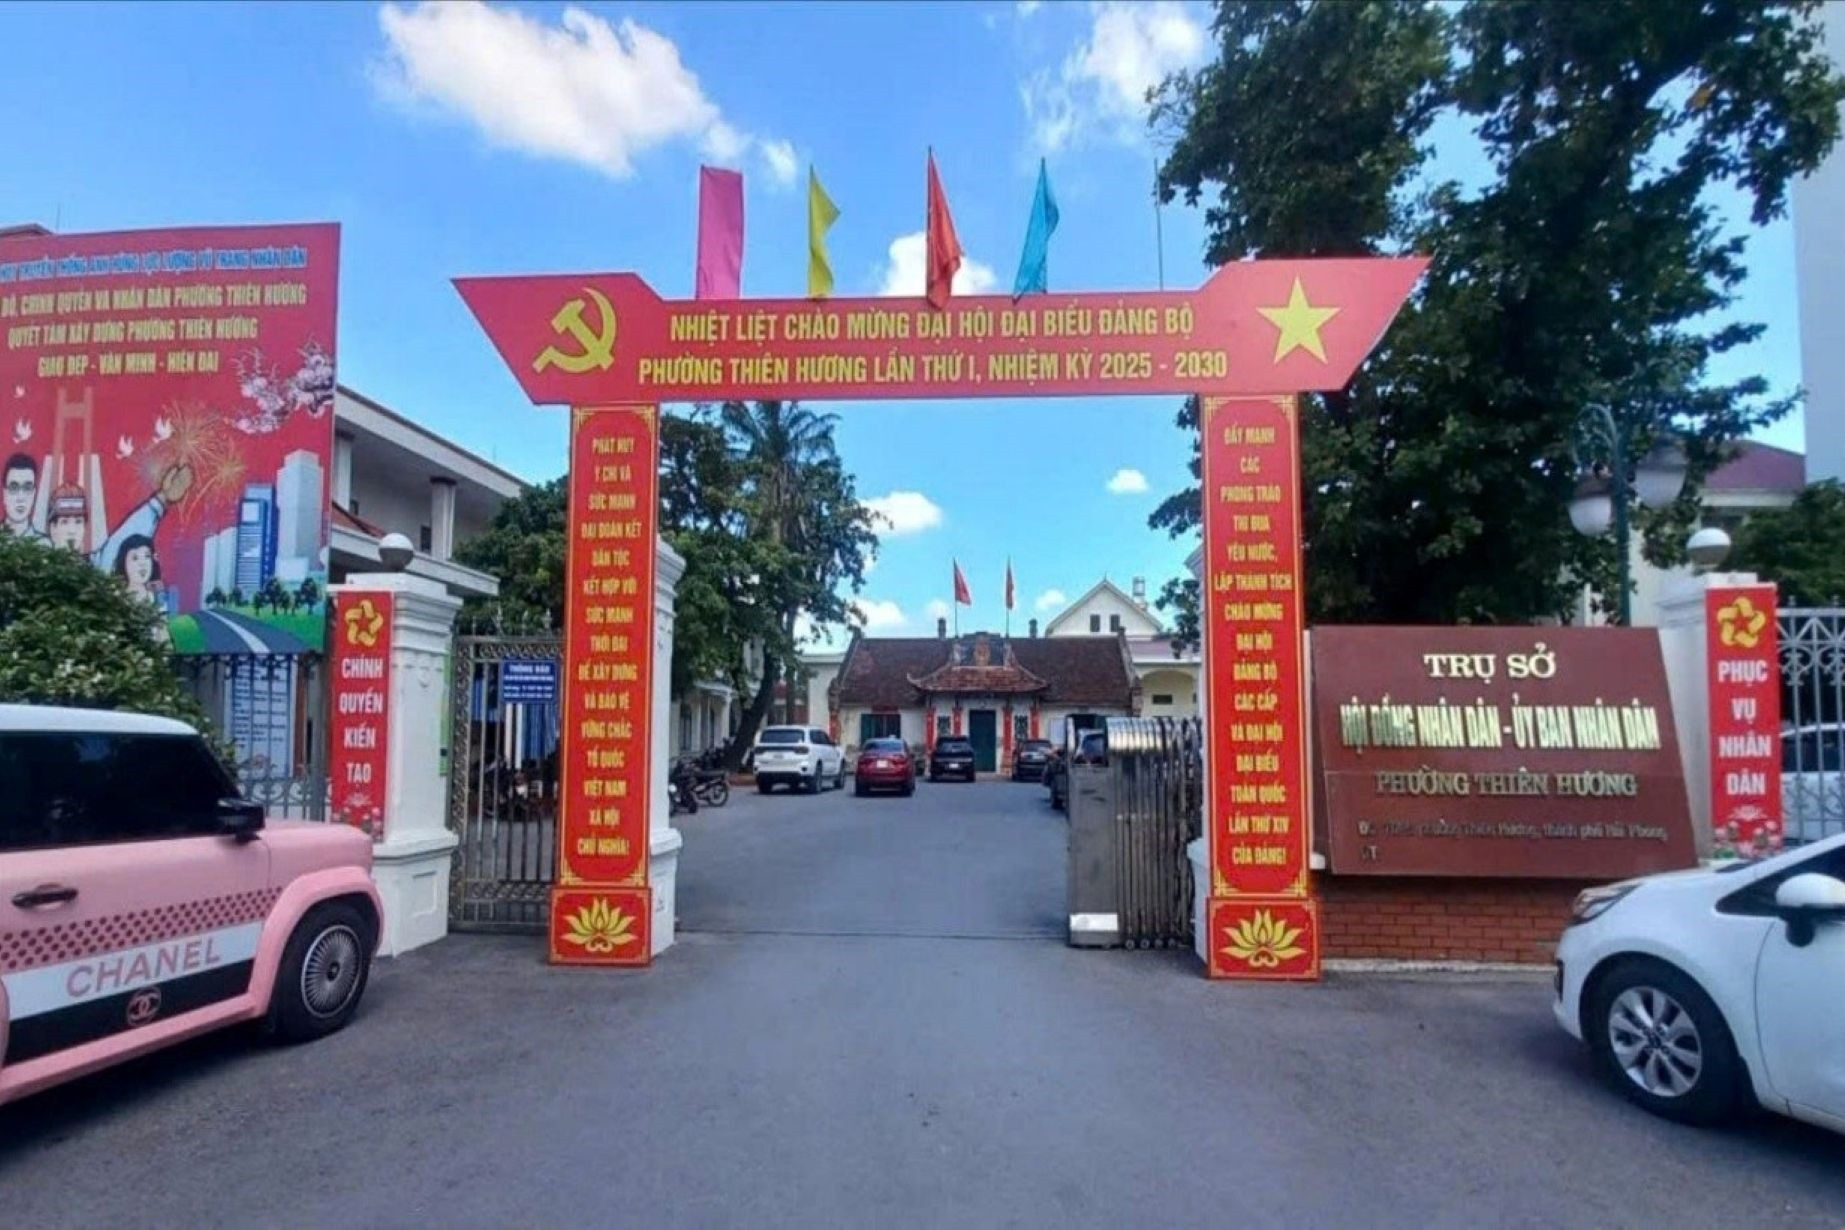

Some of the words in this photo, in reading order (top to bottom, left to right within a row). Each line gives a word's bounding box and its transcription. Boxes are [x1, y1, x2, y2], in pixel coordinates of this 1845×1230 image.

[215, 250, 249, 270] TRANG
[670, 308, 730, 346] NHIỆT
[737, 308, 778, 346] LIỆT
[785, 307, 840, 340] CHÀO
[847, 306, 910, 339] MỪNG
[917, 310, 951, 344] ĐẠI
[959, 305, 993, 343] HỘI
[1001, 309, 1036, 343] ĐẠI
[1043, 299, 1092, 336] BIỂU
[1099, 299, 1158, 335] ĐẢNG
[1165, 303, 1194, 340] BỘ
[638, 351, 724, 386] PHƯỜNG
[729, 352, 789, 384] THIÊN
[796, 355, 867, 383] HƯƠNG
[874, 347, 915, 382] LẦN
[922, 349, 964, 382] THỨ
[968, 355, 982, 384] I,
[988, 349, 1059, 387] NHIỆM
[1065, 347, 1094, 380] KỲ
[1100, 352, 1152, 379] 2025
[1174, 351, 1228, 379] 2030
[1220, 485, 1254, 504] PHONG
[341, 653, 384, 679] CHÍNH
[1423, 653, 1497, 685] TRỤ
[1506, 641, 1557, 679] SỞ
[1717, 659, 1768, 687] PHỤC
[339, 686, 383, 714] QUYỀN
[1731, 697, 1757, 725] VỤ
[344, 722, 376, 749] KIẾN
[1417, 696, 1466, 748] NHÂN
[1464, 696, 1502, 748] DÂN
[1535, 705, 1574, 748] BAN
[1572, 697, 1624, 749] NHÂN
[1622, 697, 1662, 750] DÂN
[1719, 730, 1771, 758] NHÂN
[346, 763, 372, 787] TẠO
[604, 779, 627, 797] NAM
[1376, 764, 1471, 796] PHƯỜNG
[1475, 765, 1550, 796] THIÊN
[1555, 769, 1638, 797] HƯƠNG
[1726, 768, 1767, 796] DÂN
[66, 937, 221, 998] CHANEL
